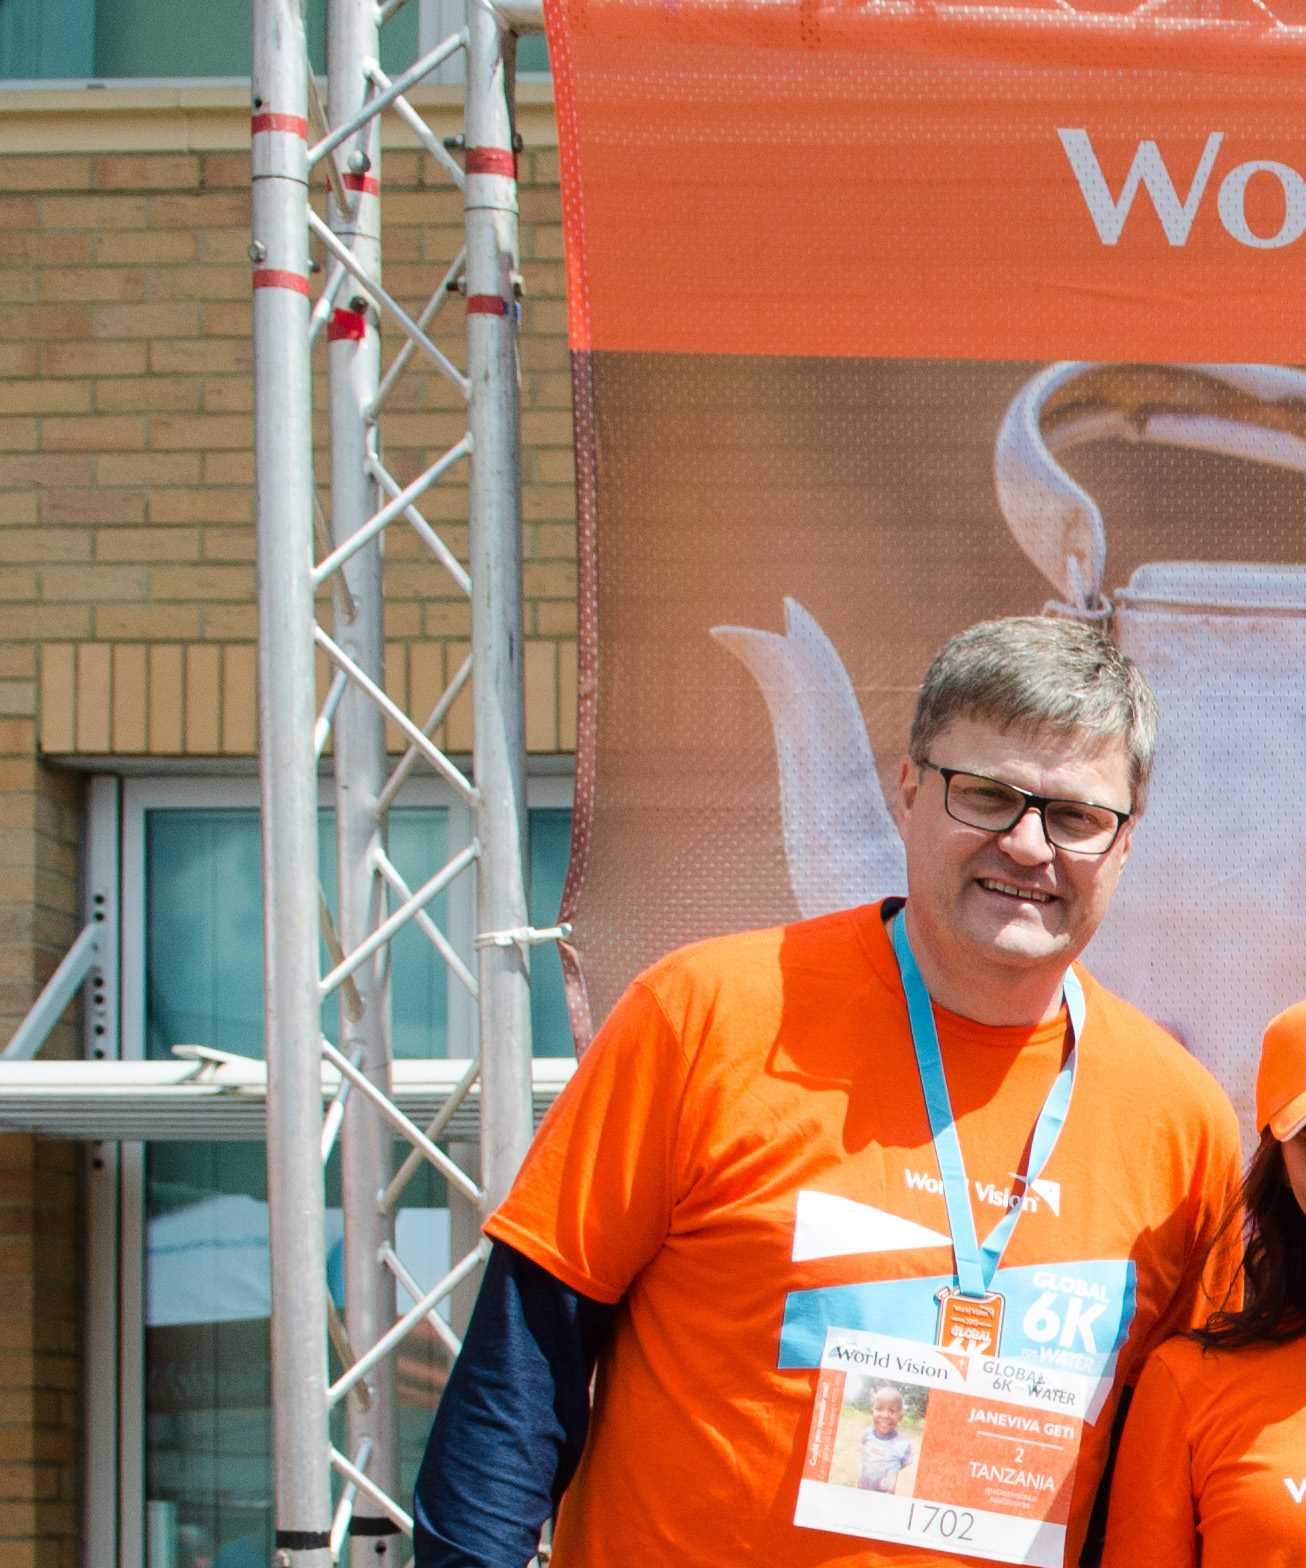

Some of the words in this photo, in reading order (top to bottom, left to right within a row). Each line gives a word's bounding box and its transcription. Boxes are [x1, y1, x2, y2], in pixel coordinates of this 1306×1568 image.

[1032, 1271, 1110, 1303] GLOBAL
[1023, 1292, 1108, 1354] 6K
[831, 1346, 890, 1369] World
[896, 1357, 949, 1381] Vision
[992, 1378, 1012, 1393] 6K
[1027, 1383, 1076, 1407] WATER
[968, 1407, 1041, 1433] JANEVIVA
[1044, 1422, 1075, 1440] GETI
[1014, 1447, 1025, 1464] 2
[968, 1461, 1055, 1493] TANZANIA
[906, 1502, 976, 1541] 1702
